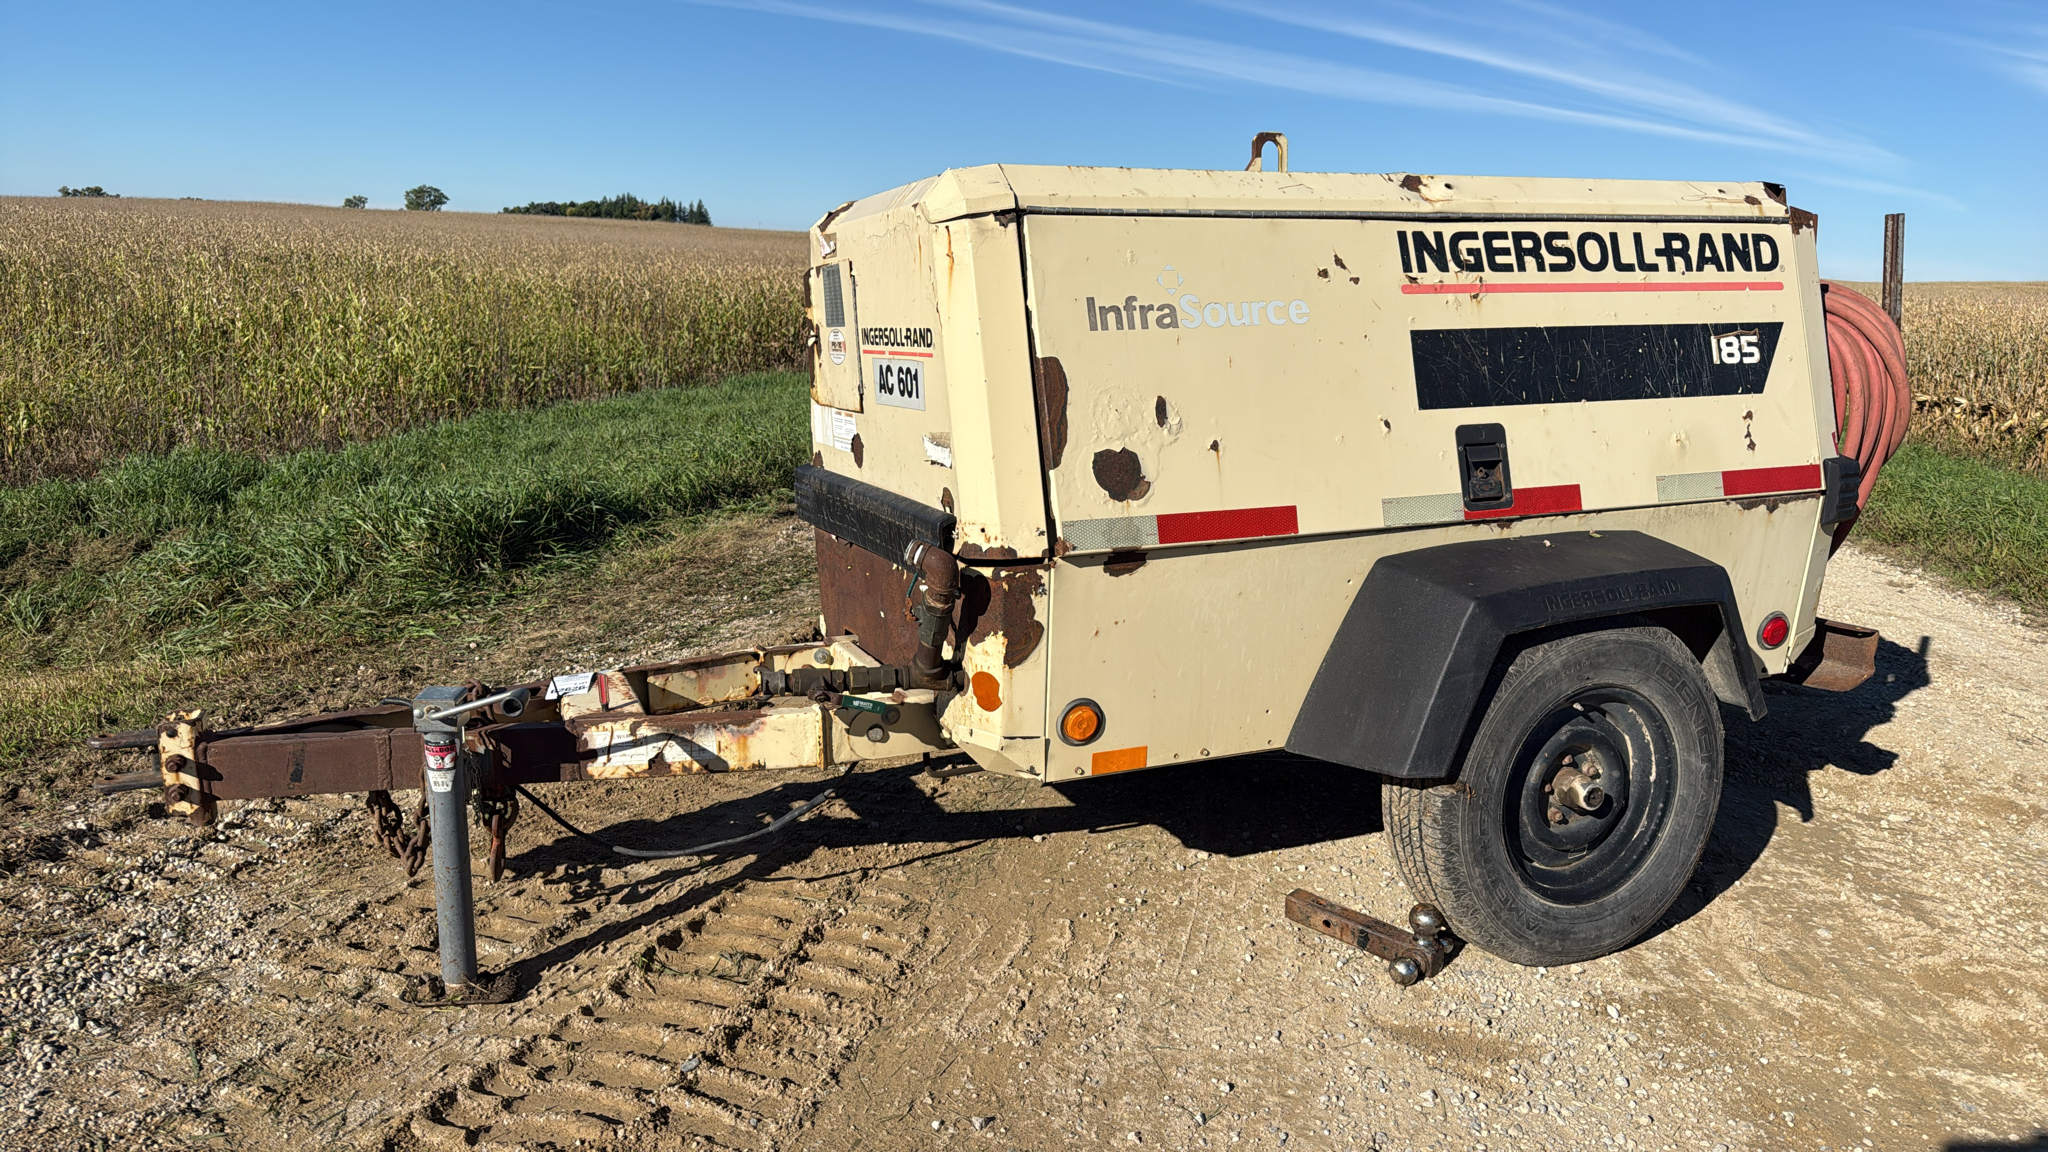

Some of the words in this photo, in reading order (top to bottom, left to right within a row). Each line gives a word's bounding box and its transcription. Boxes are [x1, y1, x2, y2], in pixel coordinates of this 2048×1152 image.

[1396, 230, 1780, 273] INGERSOLL-RAND
[1085, 293, 1311, 332] InfraSource
[861, 327, 934, 348] INGERSOLL-RAND
[1710, 335, 1760, 365] 185
[878, 364, 895, 396] AC
[897, 366, 919, 399] 601
